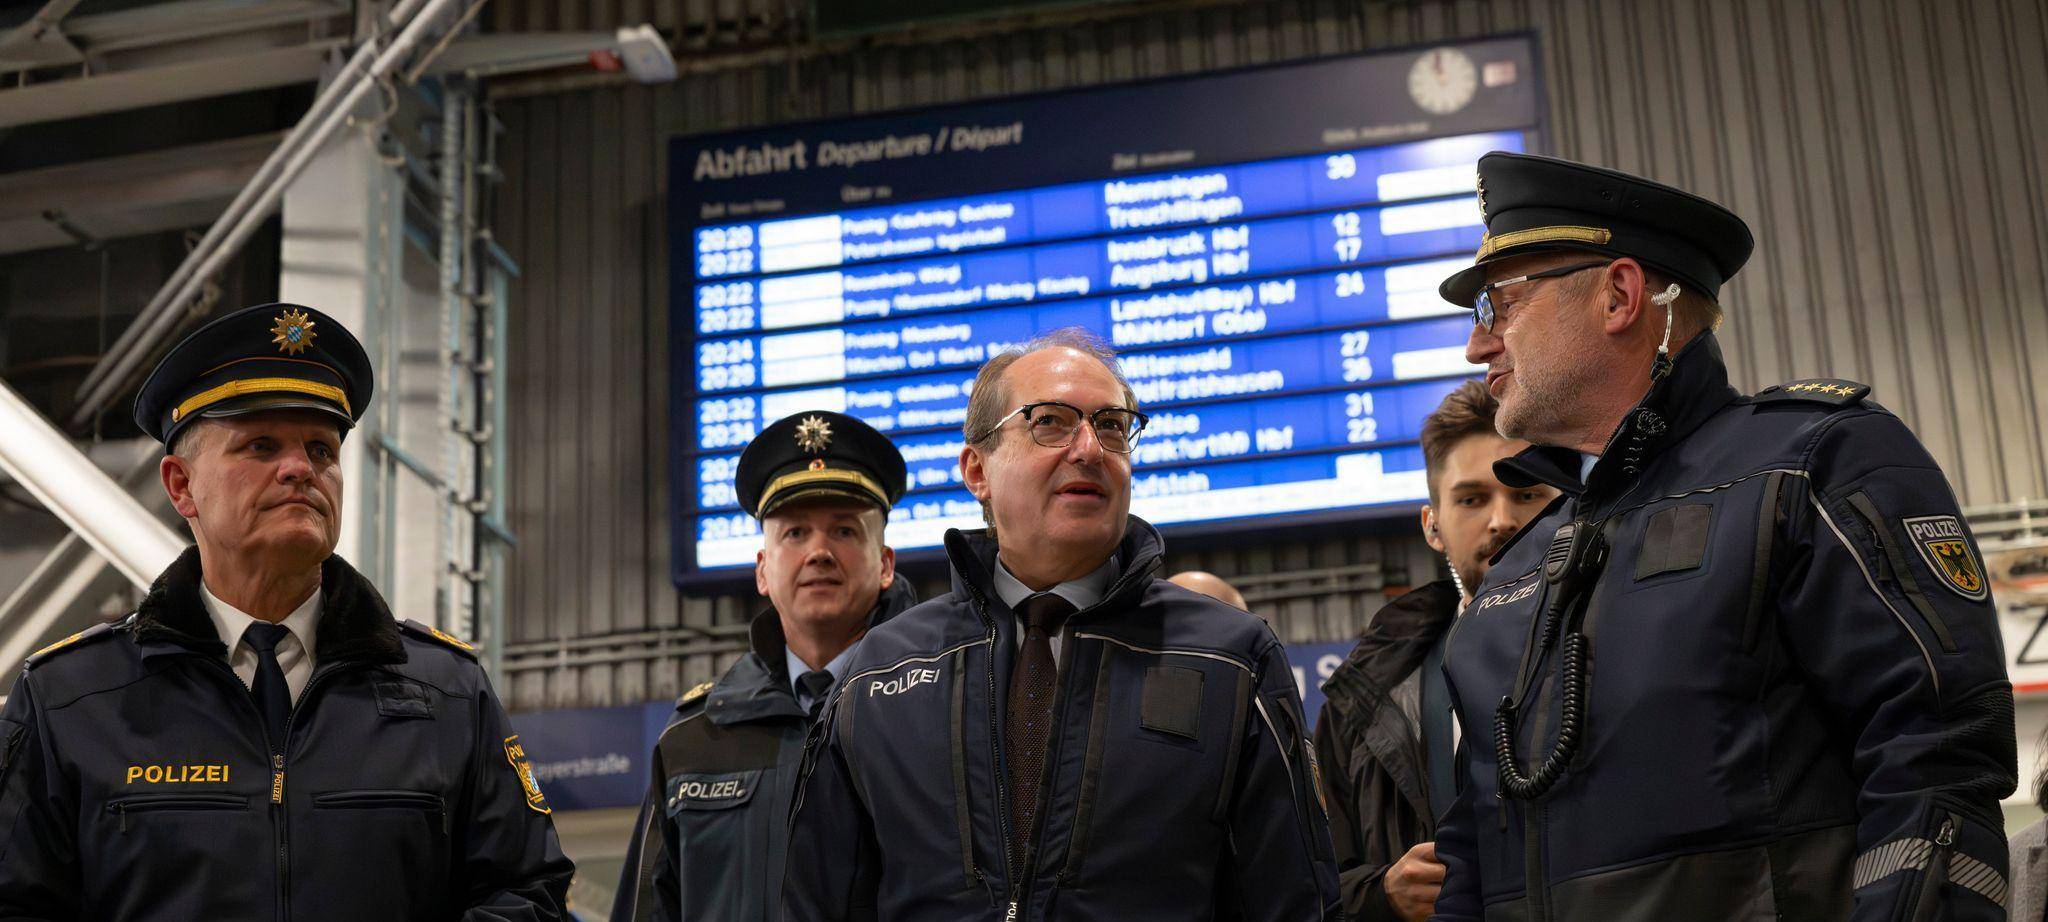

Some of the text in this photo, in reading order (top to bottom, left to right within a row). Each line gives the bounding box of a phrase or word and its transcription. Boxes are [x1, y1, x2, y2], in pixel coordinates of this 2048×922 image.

[694, 139, 806, 181] Abfahrt
[817, 133, 932, 167] Departure
[951, 121, 1023, 151] Départ
[1332, 211, 1360, 238] 12
[1333, 237, 1362, 262] 17
[1340, 330, 1370, 357] 27
[1345, 391, 1374, 417] 31
[1347, 416, 1377, 443] 22
[1912, 522, 1960, 540] POLIZEI
[1476, 579, 1541, 616] POLIZEI
[869, 668, 940, 697] POLIZEI
[126, 764, 229, 784] POLIZEI
[273, 773, 282, 801] POLIZEI
[679, 780, 738, 799] POLIZEI
